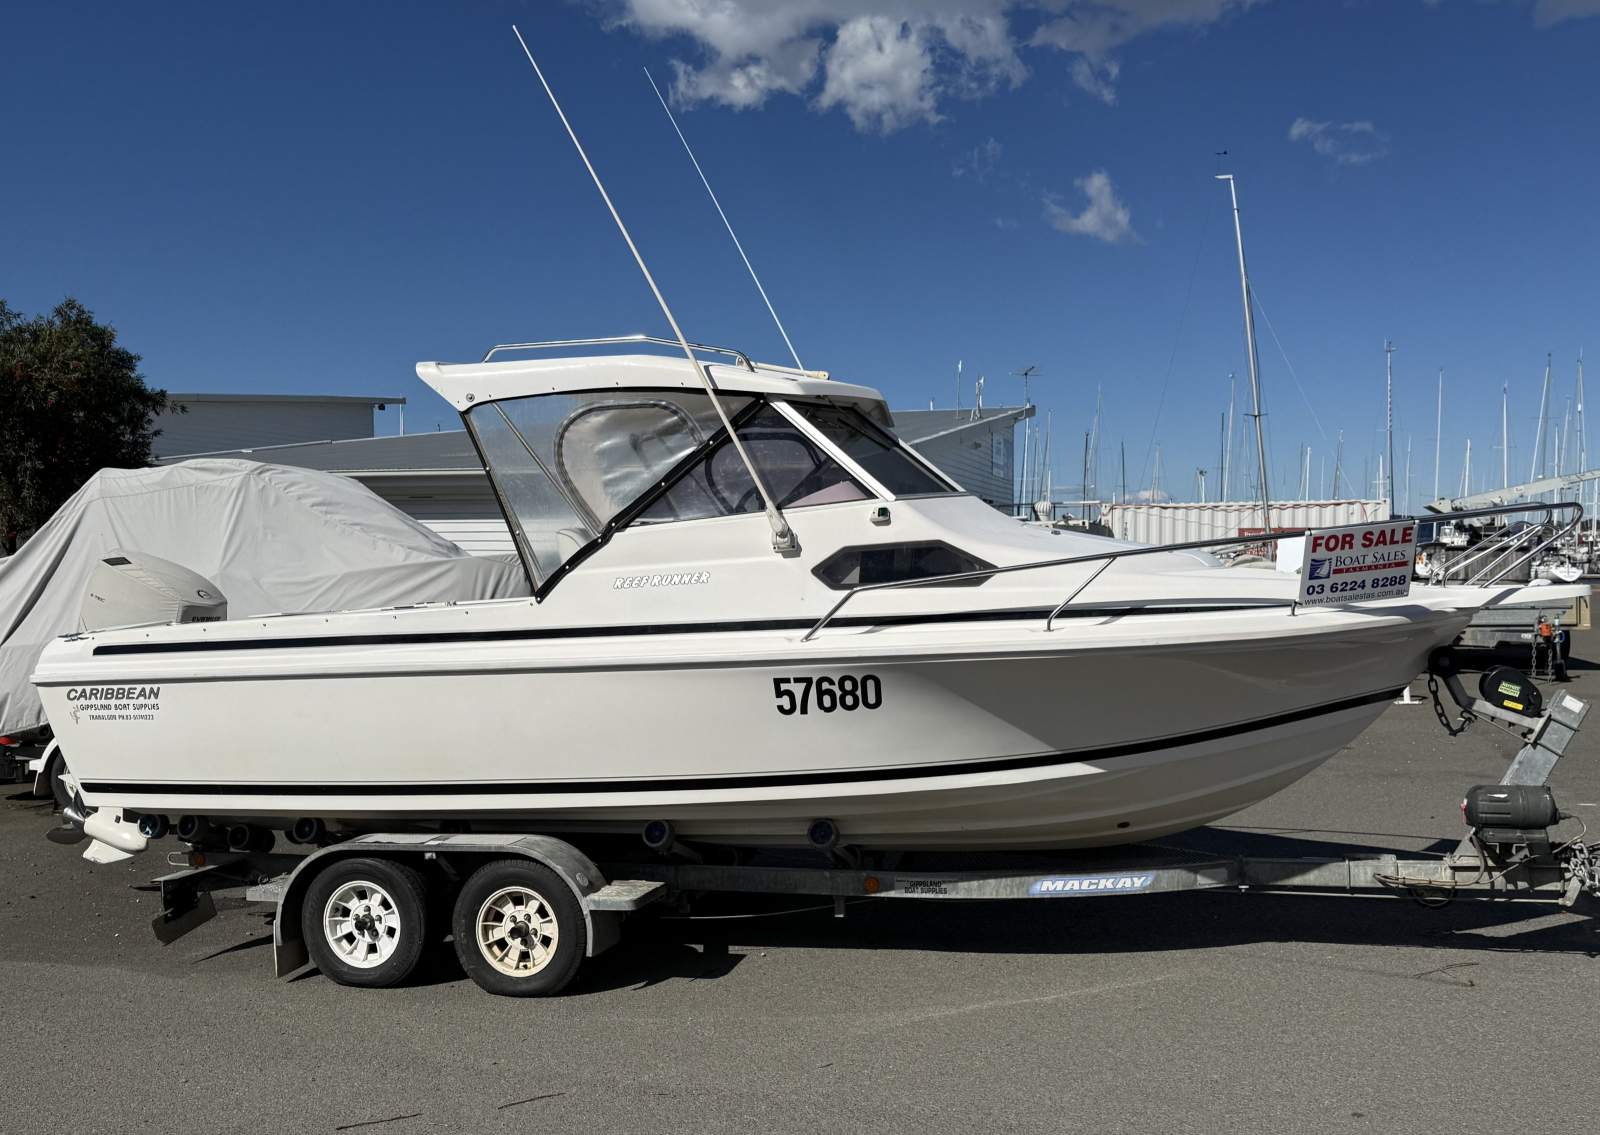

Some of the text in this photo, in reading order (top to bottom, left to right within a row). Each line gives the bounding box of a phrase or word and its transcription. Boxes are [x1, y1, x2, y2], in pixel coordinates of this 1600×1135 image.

[1311, 526, 1414, 553] FOR SALE
[613, 571, 711, 589] REEF RUNNER
[1306, 575, 1407, 596] 03 6224 8288
[66, 686, 161, 701] CARIBBEAN
[772, 674, 882, 716] 57680
[114, 703, 130, 711] BOAT
[132, 703, 160, 711] SUPPLIES
[1040, 876, 1147, 892] MACKAY
